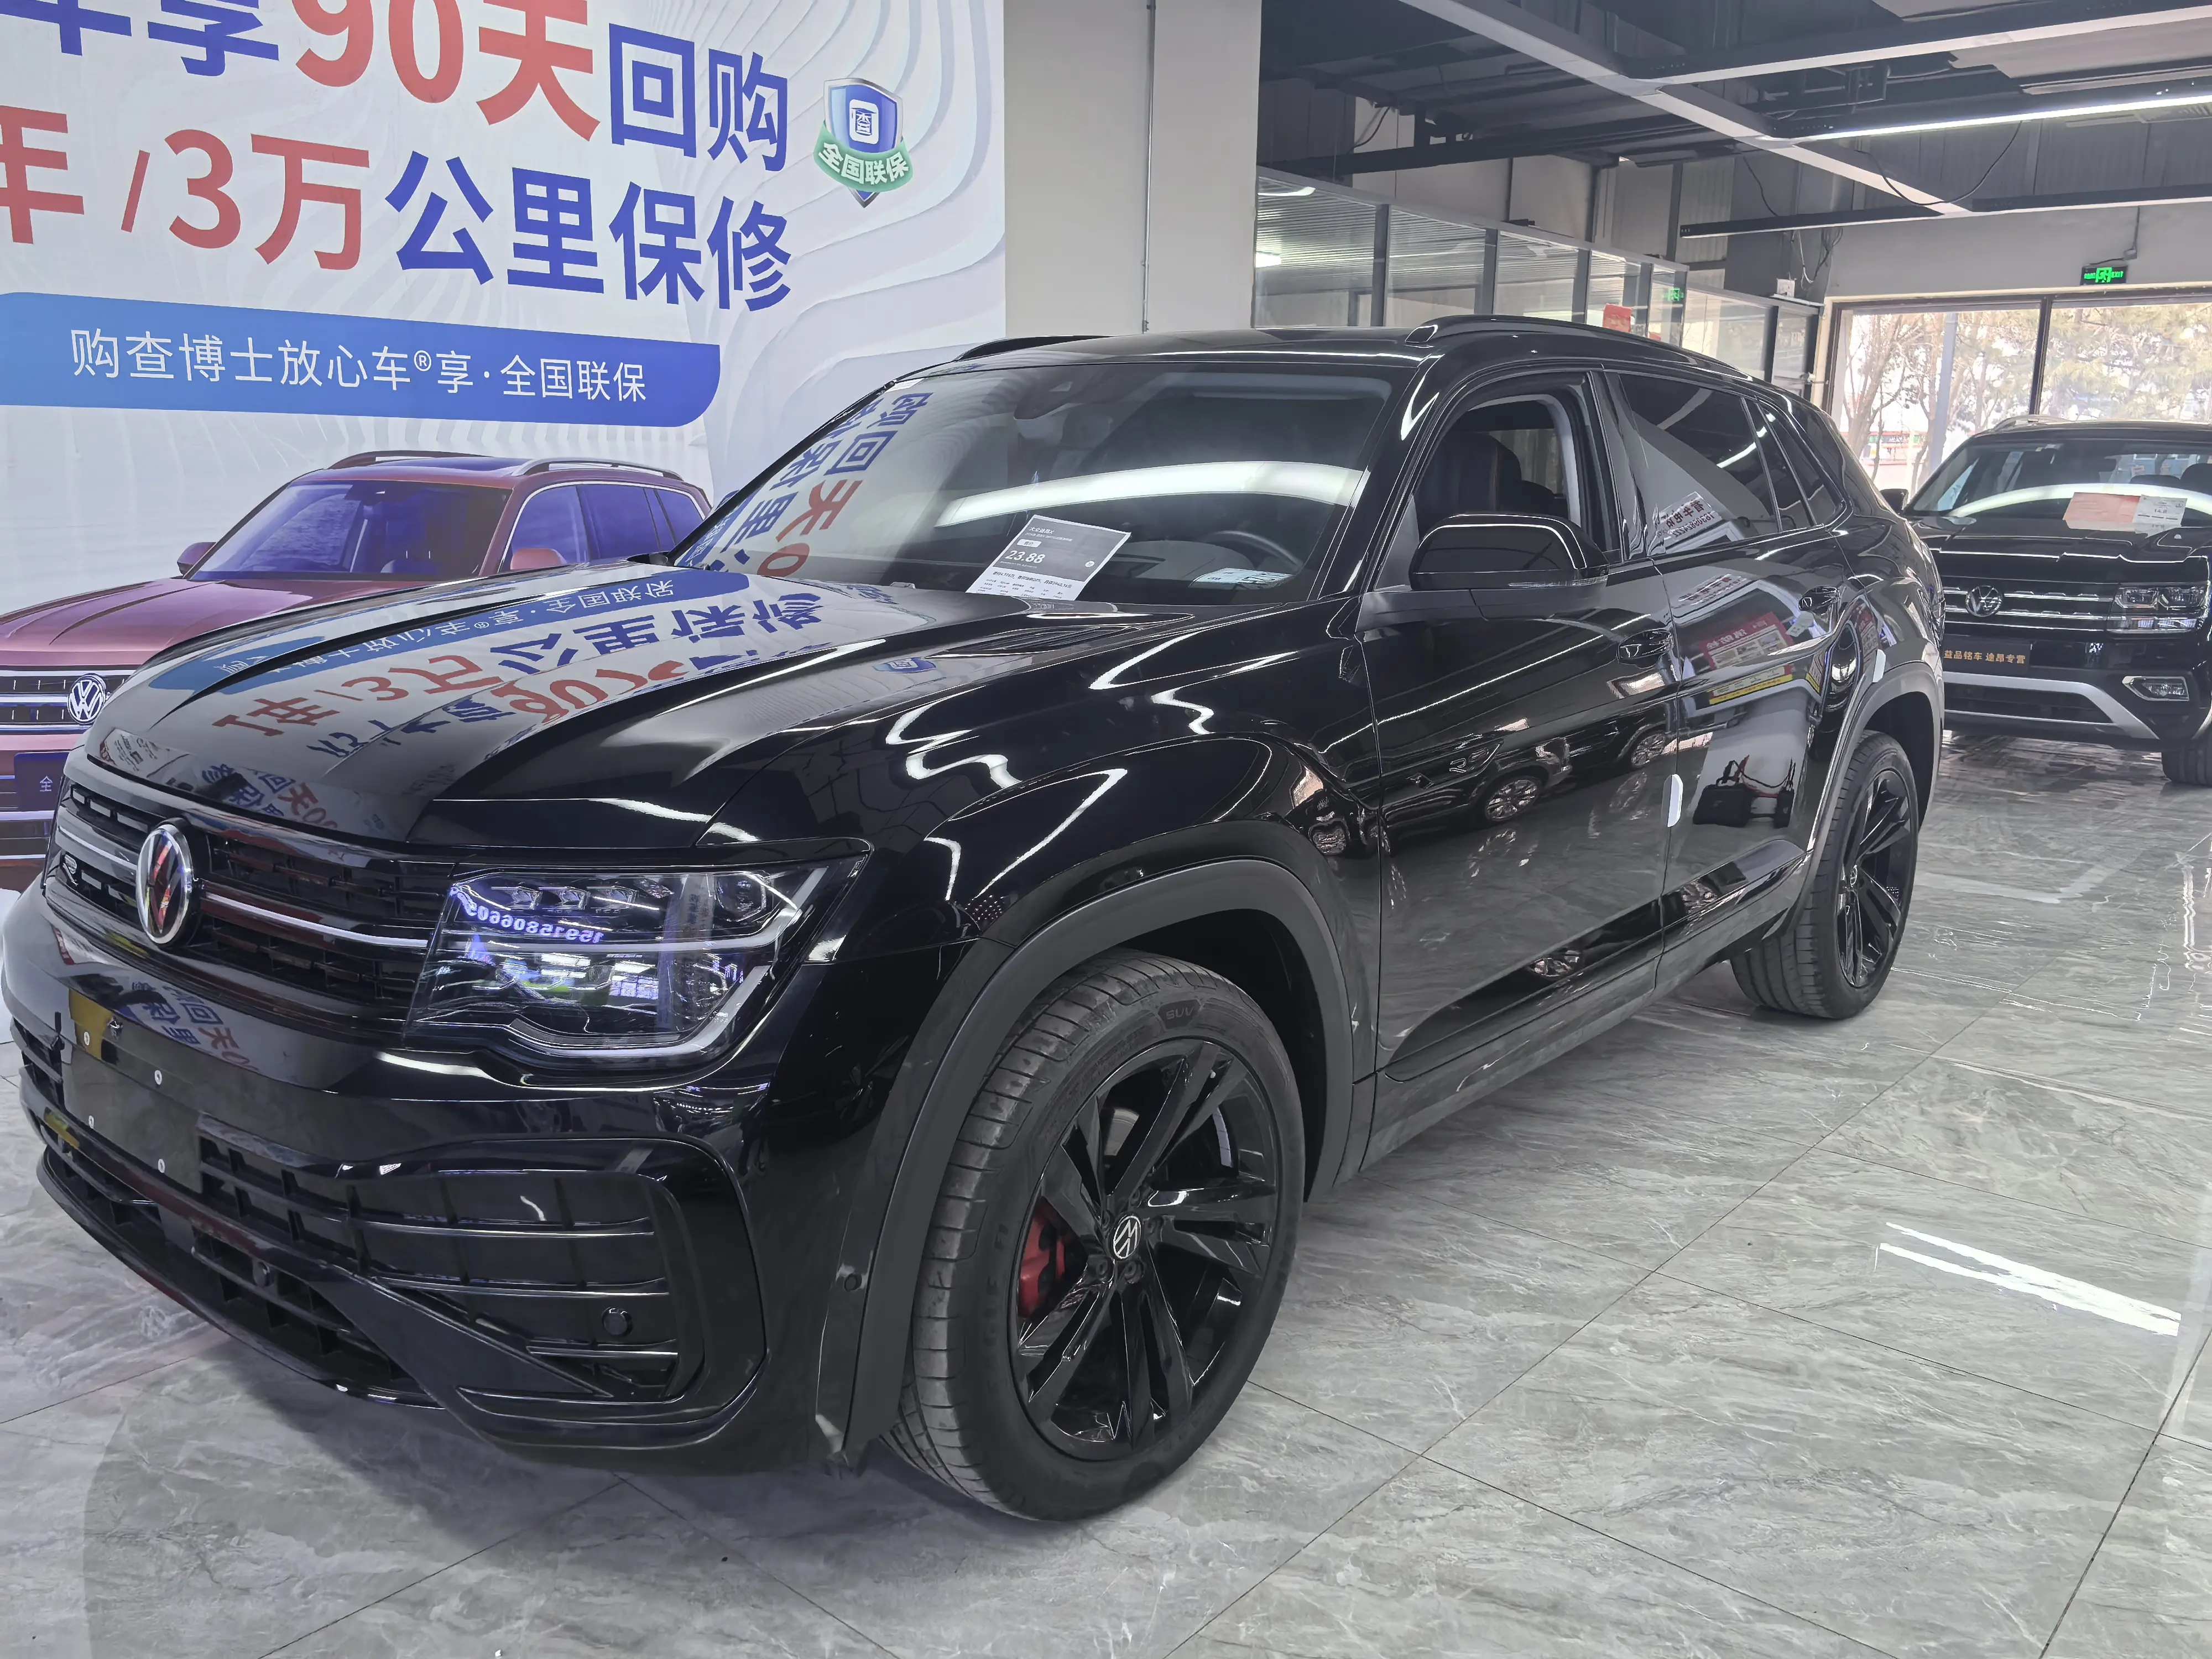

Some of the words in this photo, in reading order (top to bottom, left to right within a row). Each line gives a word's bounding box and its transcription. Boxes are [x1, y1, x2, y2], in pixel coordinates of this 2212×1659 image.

[818, 143, 909, 185] 全国联保
[1004, 550, 1046, 564] 23.88
[39, 775, 53, 792] 全
[1165, 1006, 1194, 1021] SUV
